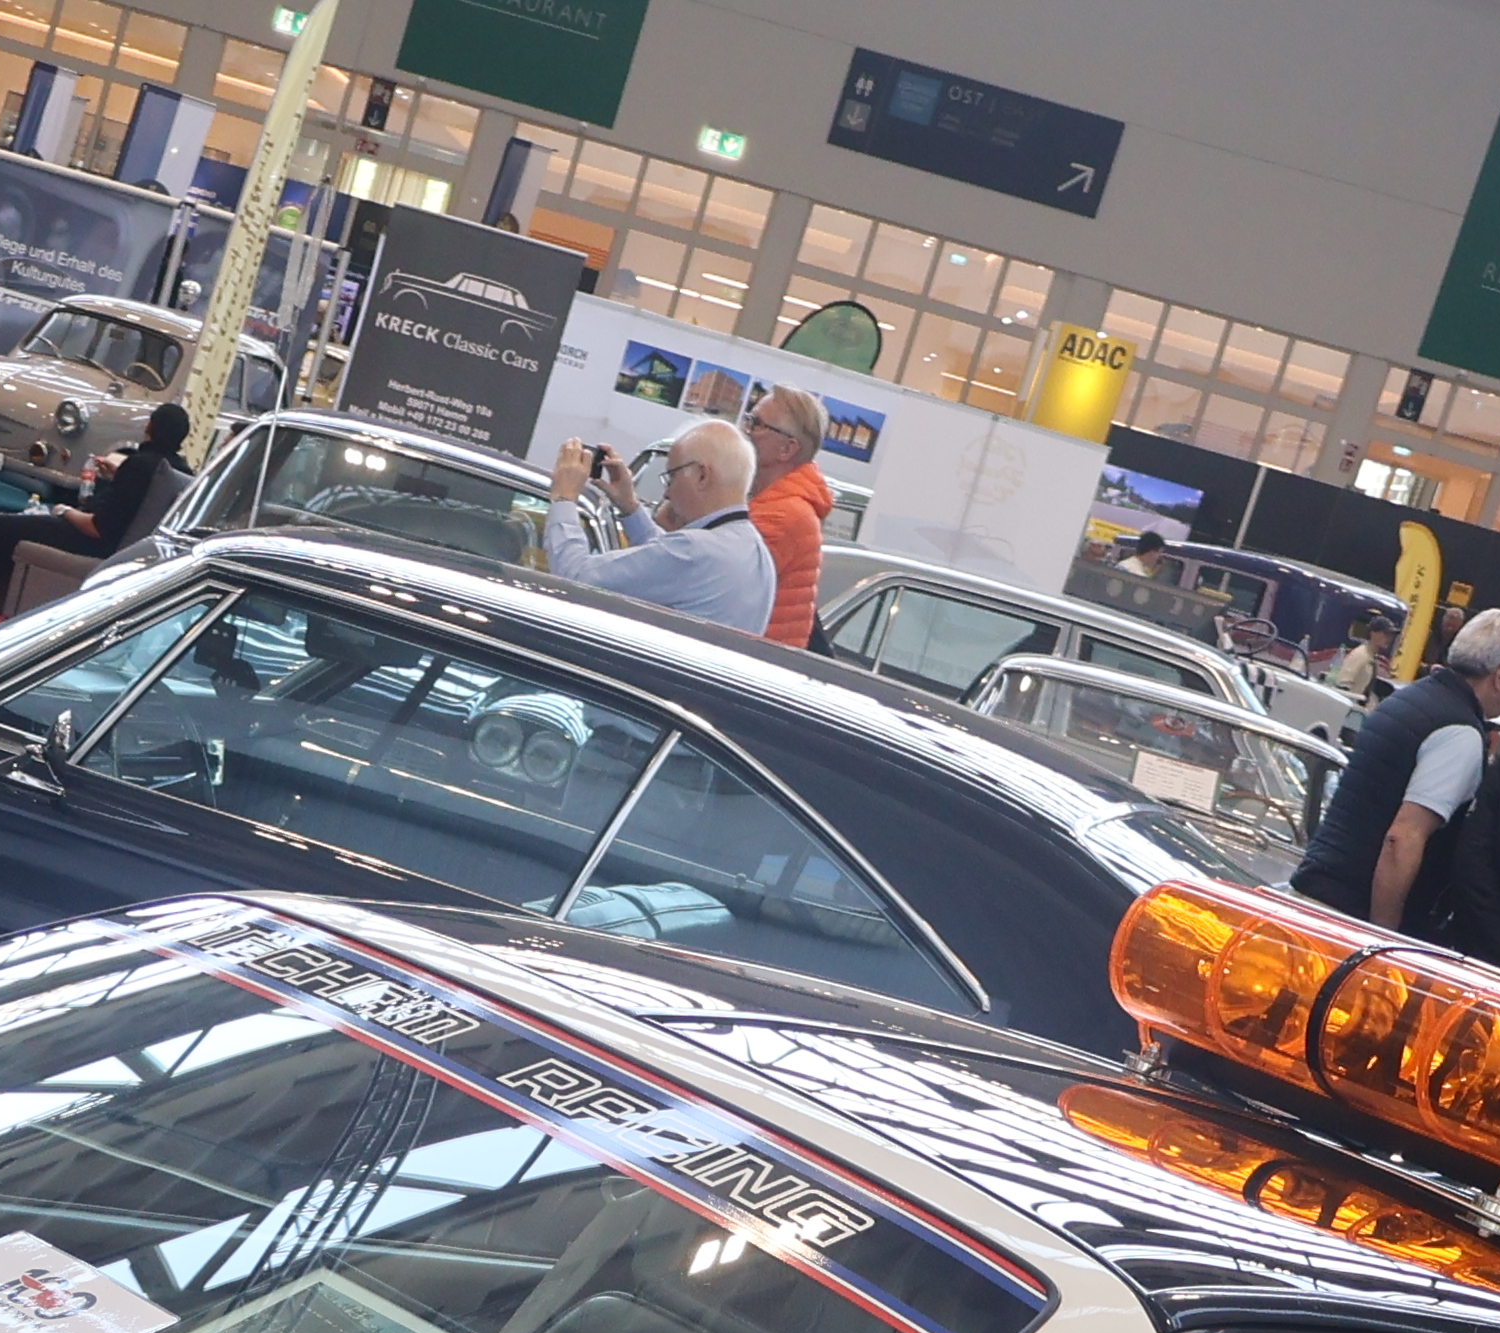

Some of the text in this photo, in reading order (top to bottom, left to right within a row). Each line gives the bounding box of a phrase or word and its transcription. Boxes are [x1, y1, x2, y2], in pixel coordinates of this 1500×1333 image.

[949, 84, 985, 106] OST
[11, 259, 86, 294] Kulturgutes
[29, 241, 56, 264] und
[57, 251, 98, 276] Erhalt
[100, 263, 124, 283] des
[375, 312, 540, 373] KRECK Classic Cars
[1059, 332, 1128, 372] ADAC
[436, 405, 468, 422] Hamm
[496, 1058, 875, 1248] RACING
